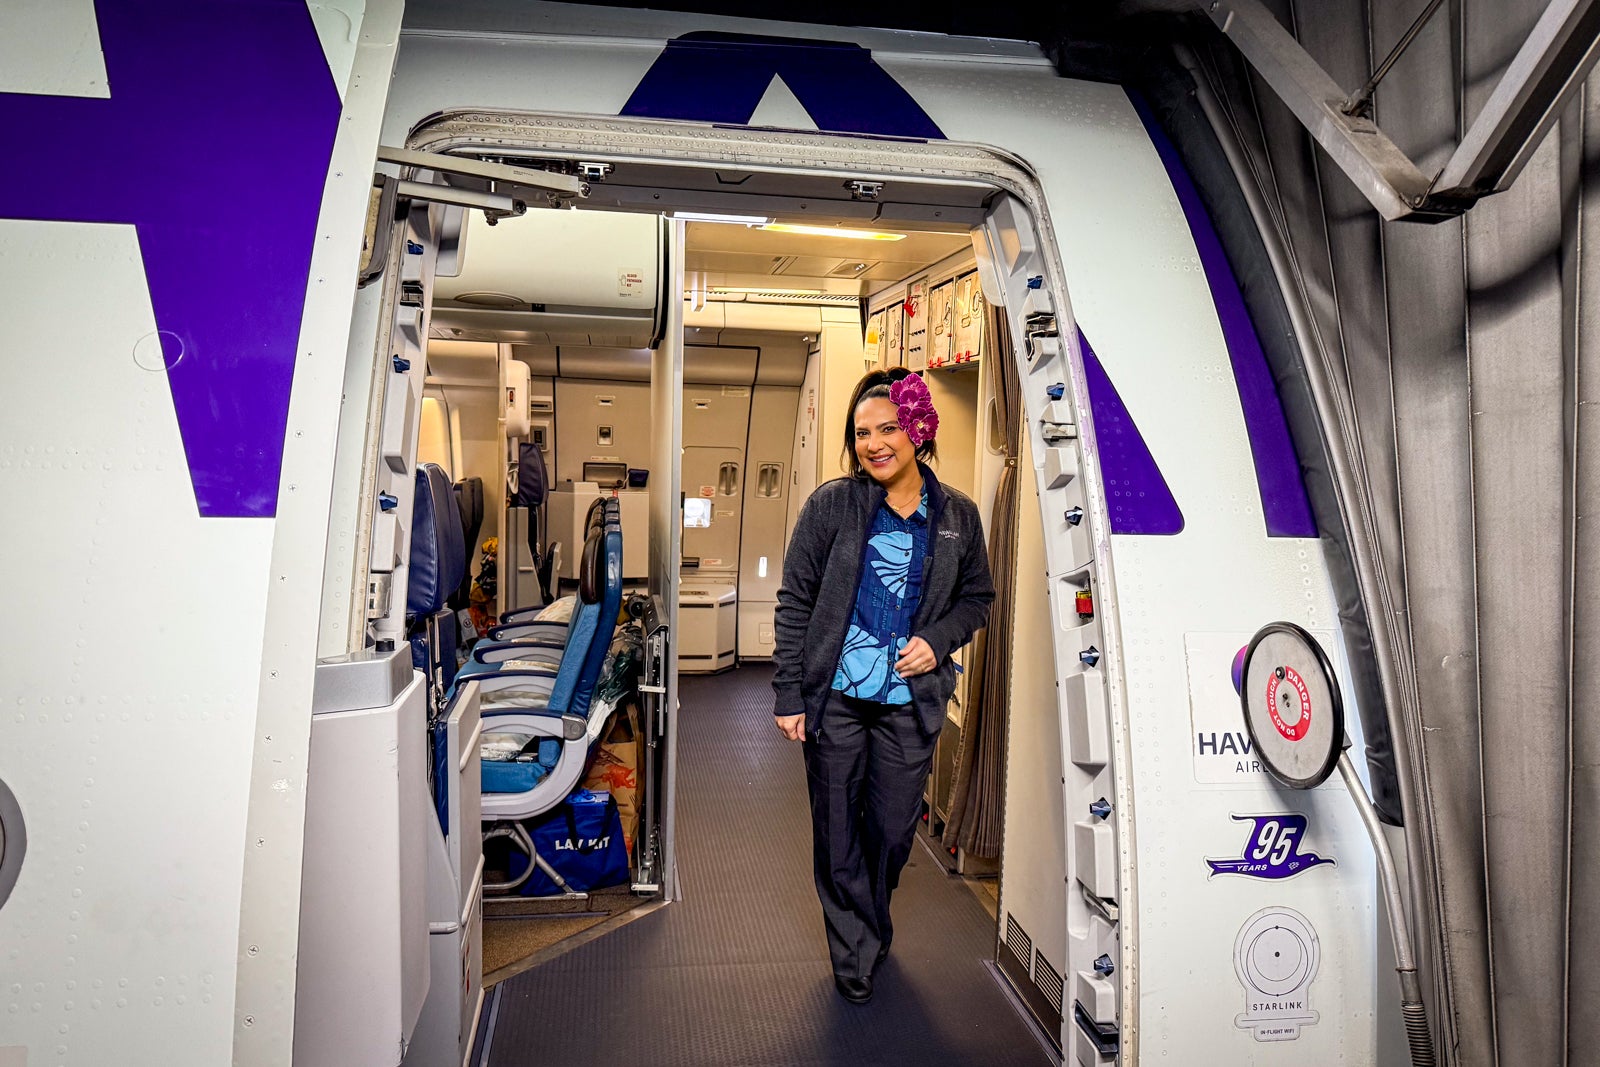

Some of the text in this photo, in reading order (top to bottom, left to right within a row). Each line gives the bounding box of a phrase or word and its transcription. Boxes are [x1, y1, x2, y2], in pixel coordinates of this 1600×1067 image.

[1269, 678, 1277, 712] TOUCH
[1287, 670, 1310, 721] DANGER
[1273, 713, 1286, 732] NOT
[588, 835, 611, 850] KIT
[1252, 820, 1298, 866] 95
[1236, 863, 1268, 872] YEARS
[1252, 1001, 1302, 1011] STARLINK
